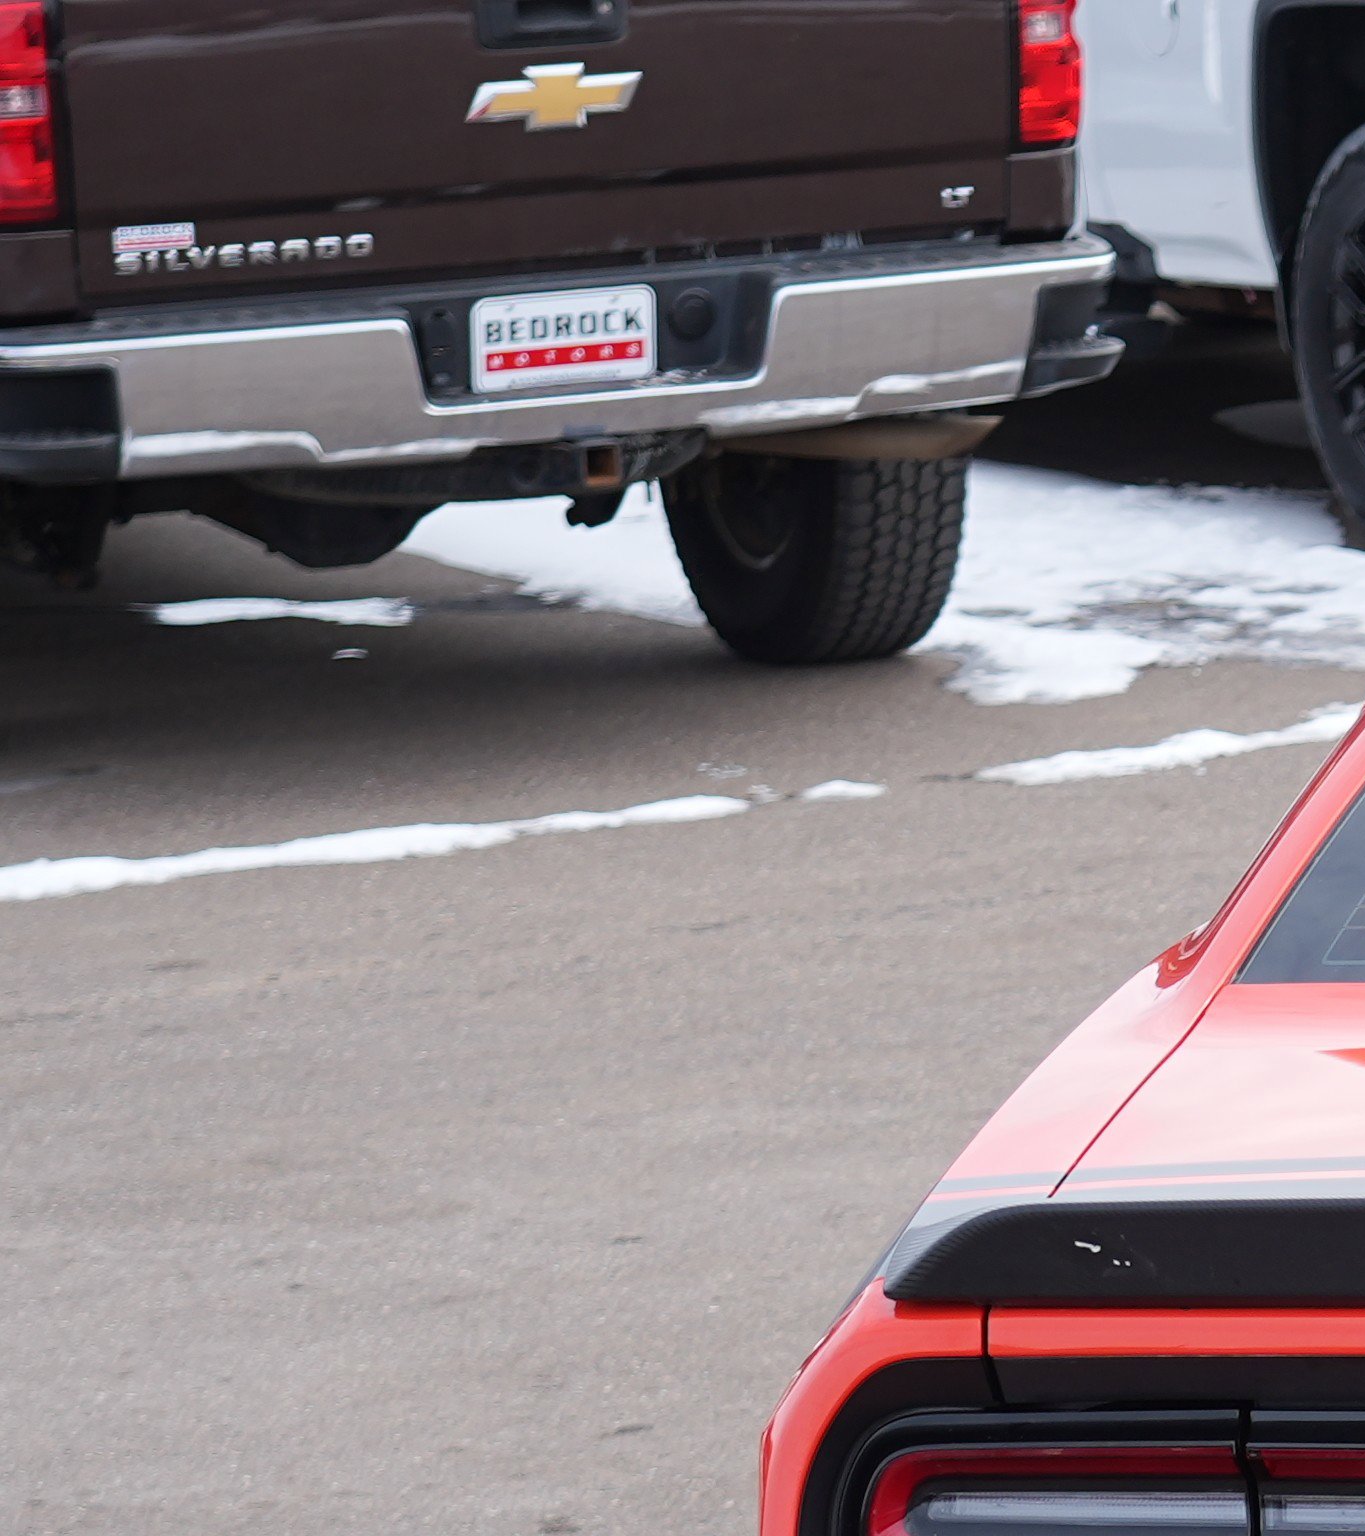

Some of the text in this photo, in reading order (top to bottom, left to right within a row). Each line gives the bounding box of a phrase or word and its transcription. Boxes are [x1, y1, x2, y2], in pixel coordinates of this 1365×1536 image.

[114, 233, 374, 275] SILVERADO
[485, 306, 645, 344] BEDROCK
[489, 342, 640, 370] MOTORS
